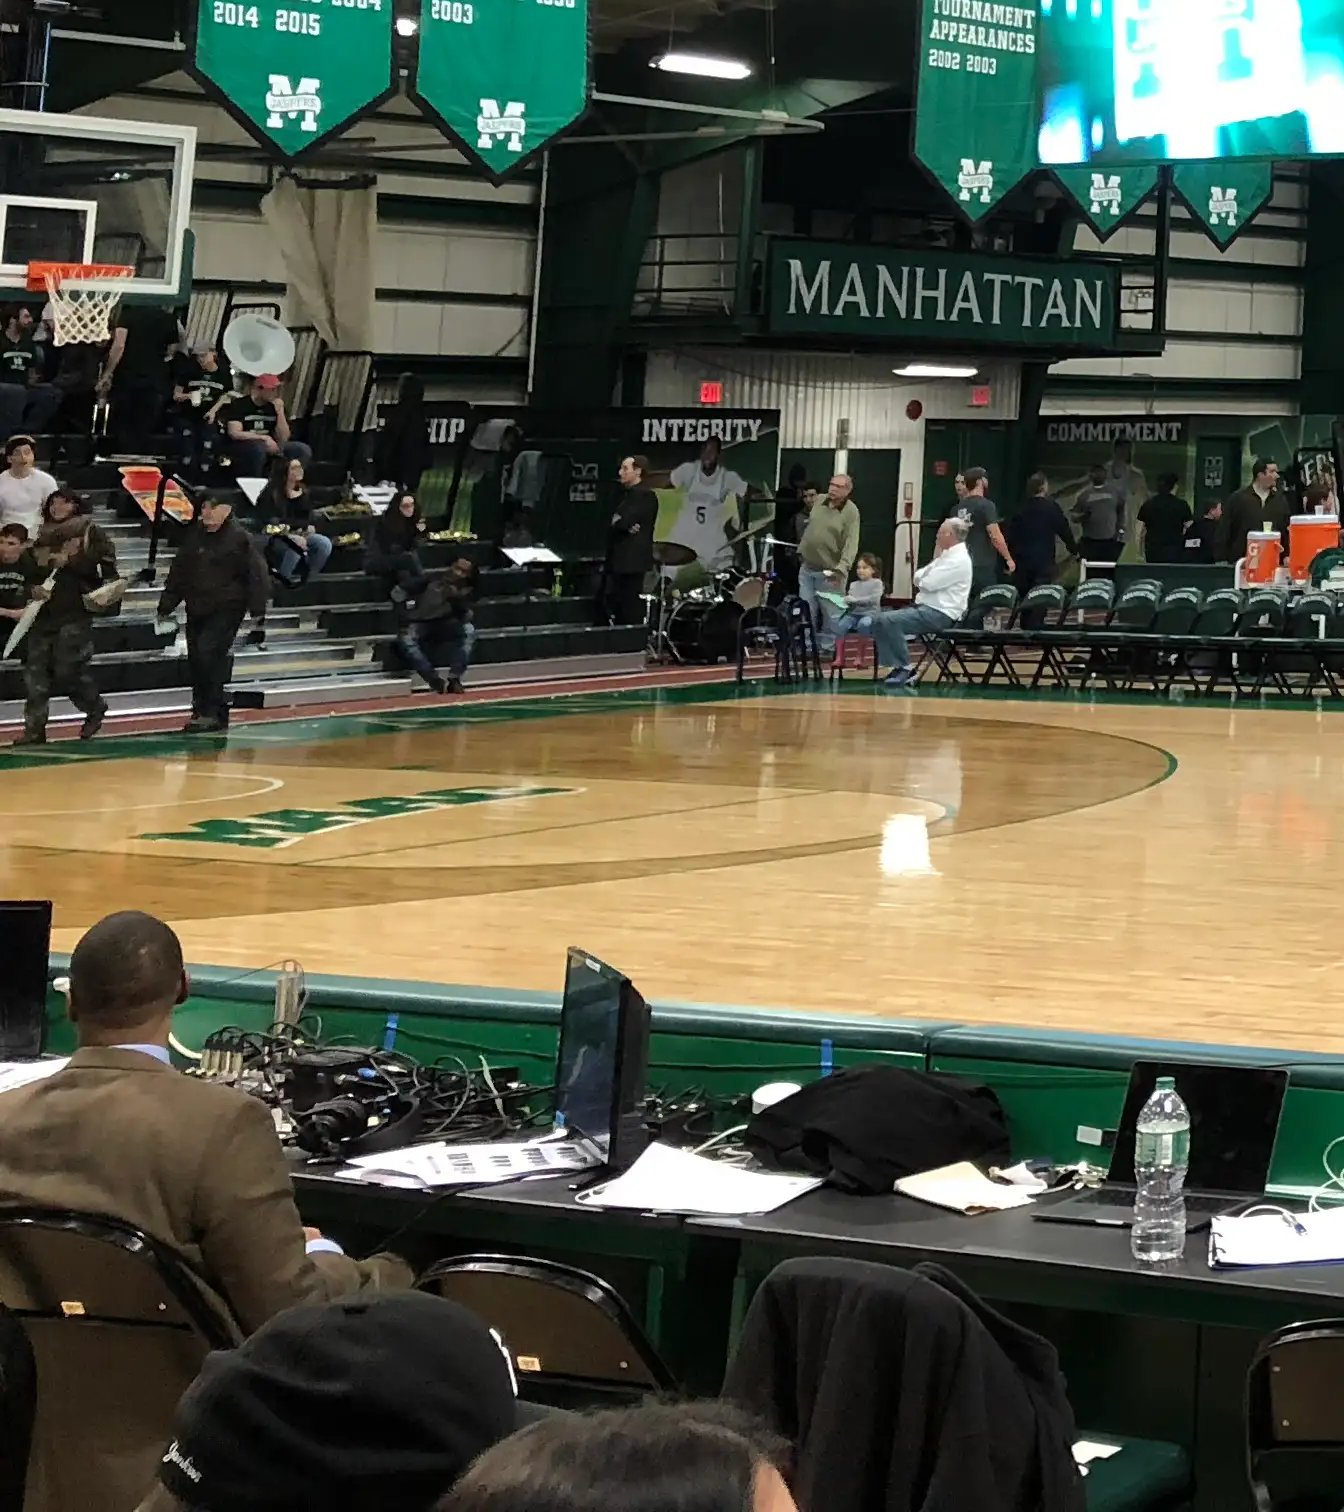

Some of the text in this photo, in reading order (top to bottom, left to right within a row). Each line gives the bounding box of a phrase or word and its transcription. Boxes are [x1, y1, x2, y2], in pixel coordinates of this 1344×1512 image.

[213, 1, 320, 35] 2014 2015
[432, 0, 473, 24] 2003
[930, 19, 1035, 54] APPEARANCES
[929, 49, 997, 75] 2002 2003
[786, 259, 1104, 329] MANHATTAN
[642, 418, 762, 443] INTEGRITY
[1046, 422, 1182, 443] COMMITMENT
